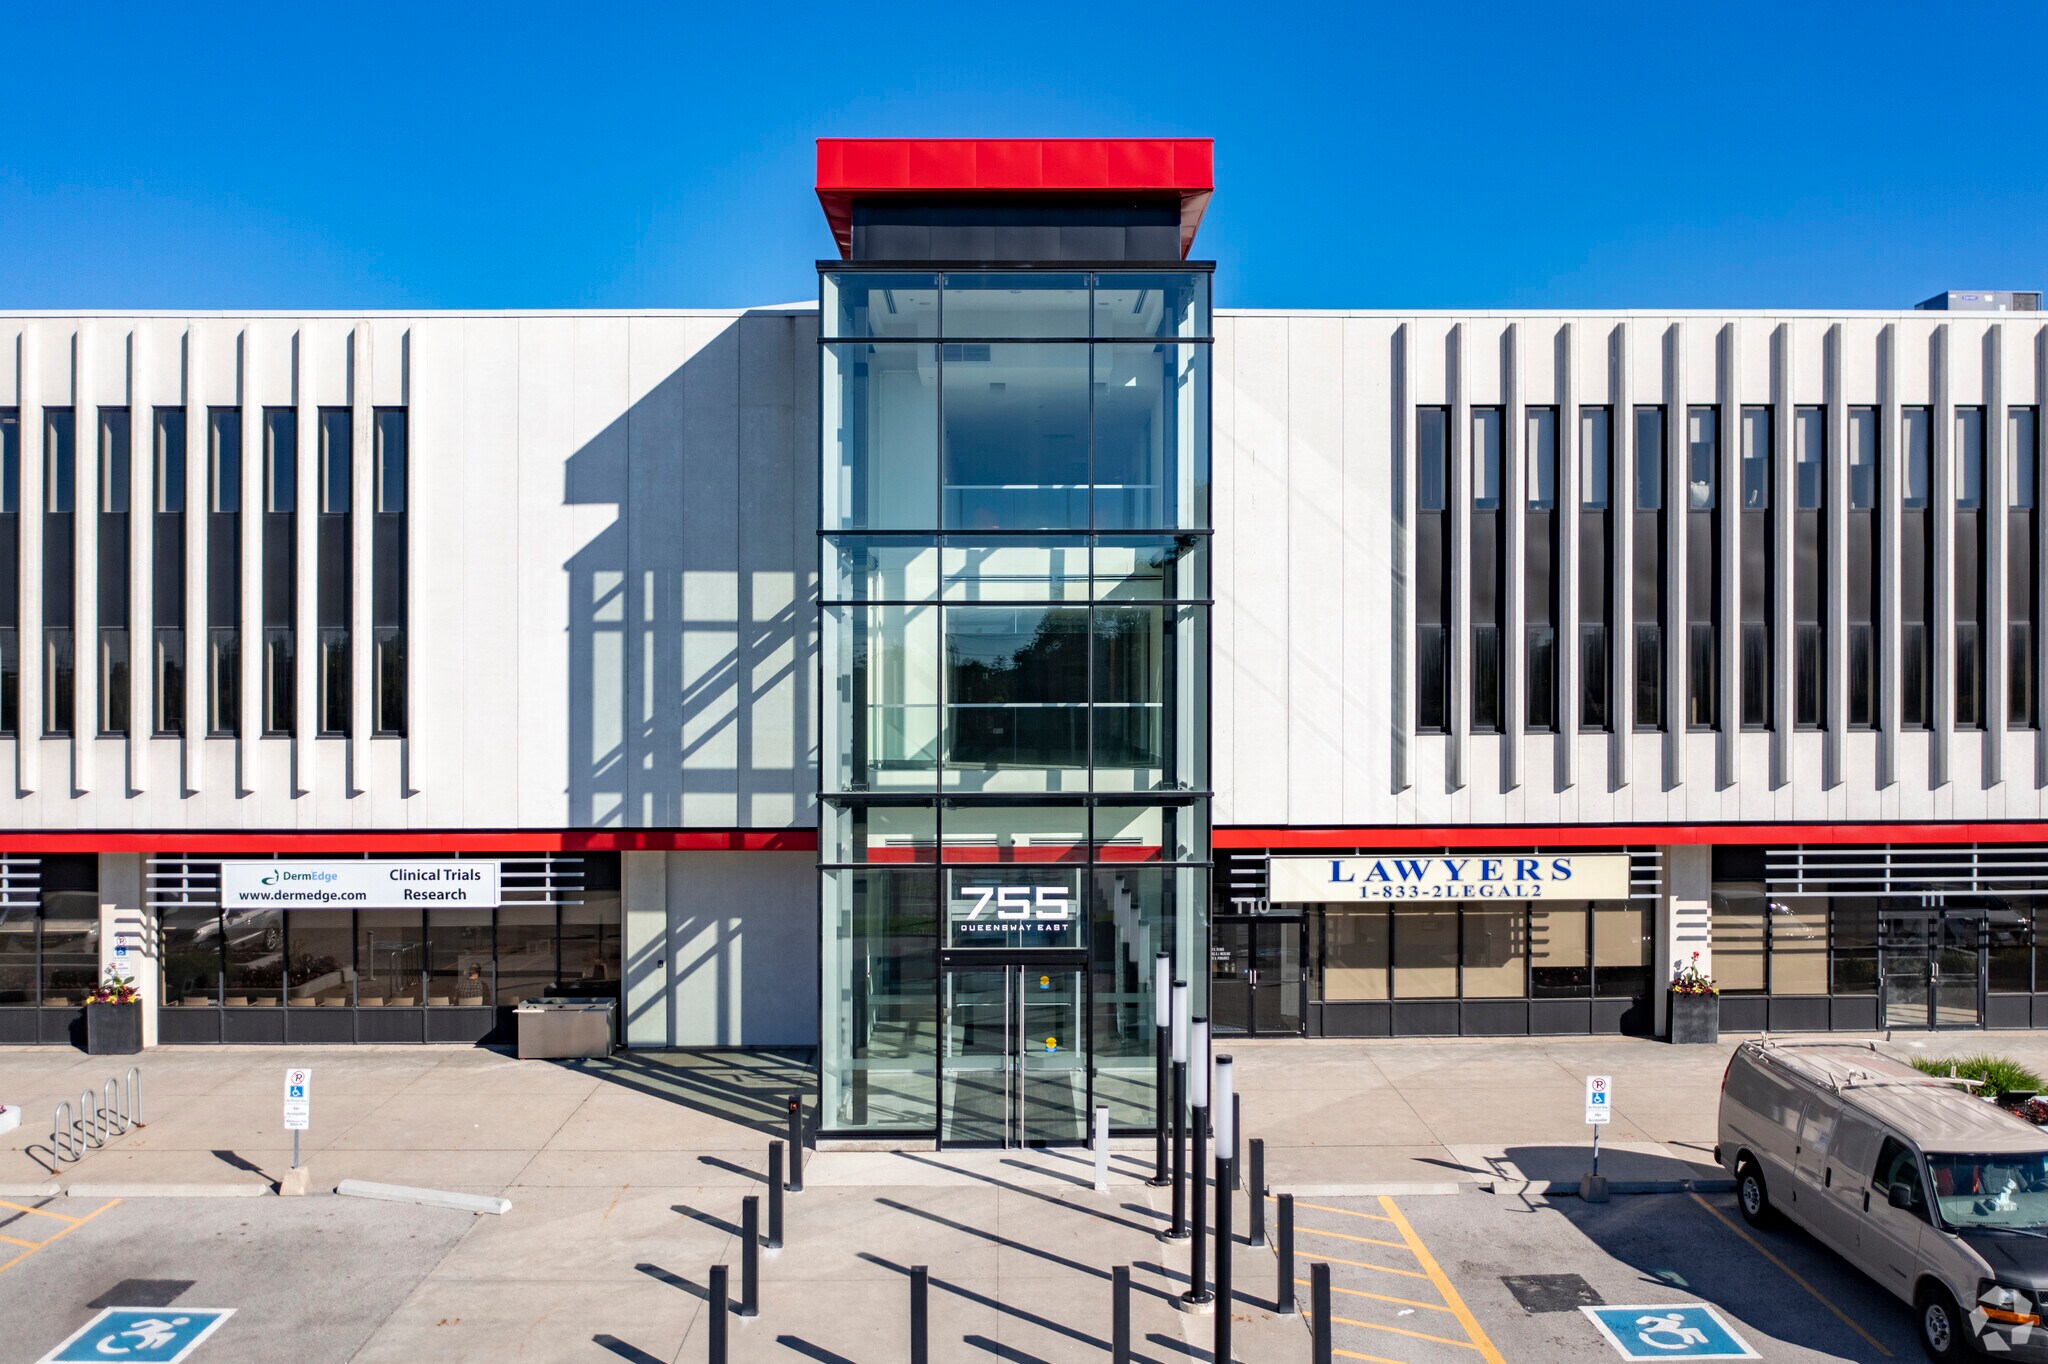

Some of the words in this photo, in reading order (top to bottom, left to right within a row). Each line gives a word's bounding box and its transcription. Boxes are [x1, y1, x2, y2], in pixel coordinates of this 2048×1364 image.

[389, 868, 441, 881] Clinical
[443, 868, 481, 881] Trials
[1328, 858, 1573, 883] LAWYERS
[283, 871, 338, 884] DermEdge
[239, 889, 367, 902] www.dermedge.com
[403, 888, 467, 900] Research
[1359, 885, 1542, 898] 1-833-2LEGAL2
[961, 887, 1069, 920] 755
[1233, 897, 1270, 914] 110
[960, 924, 1032, 932] QUEENSWAY
